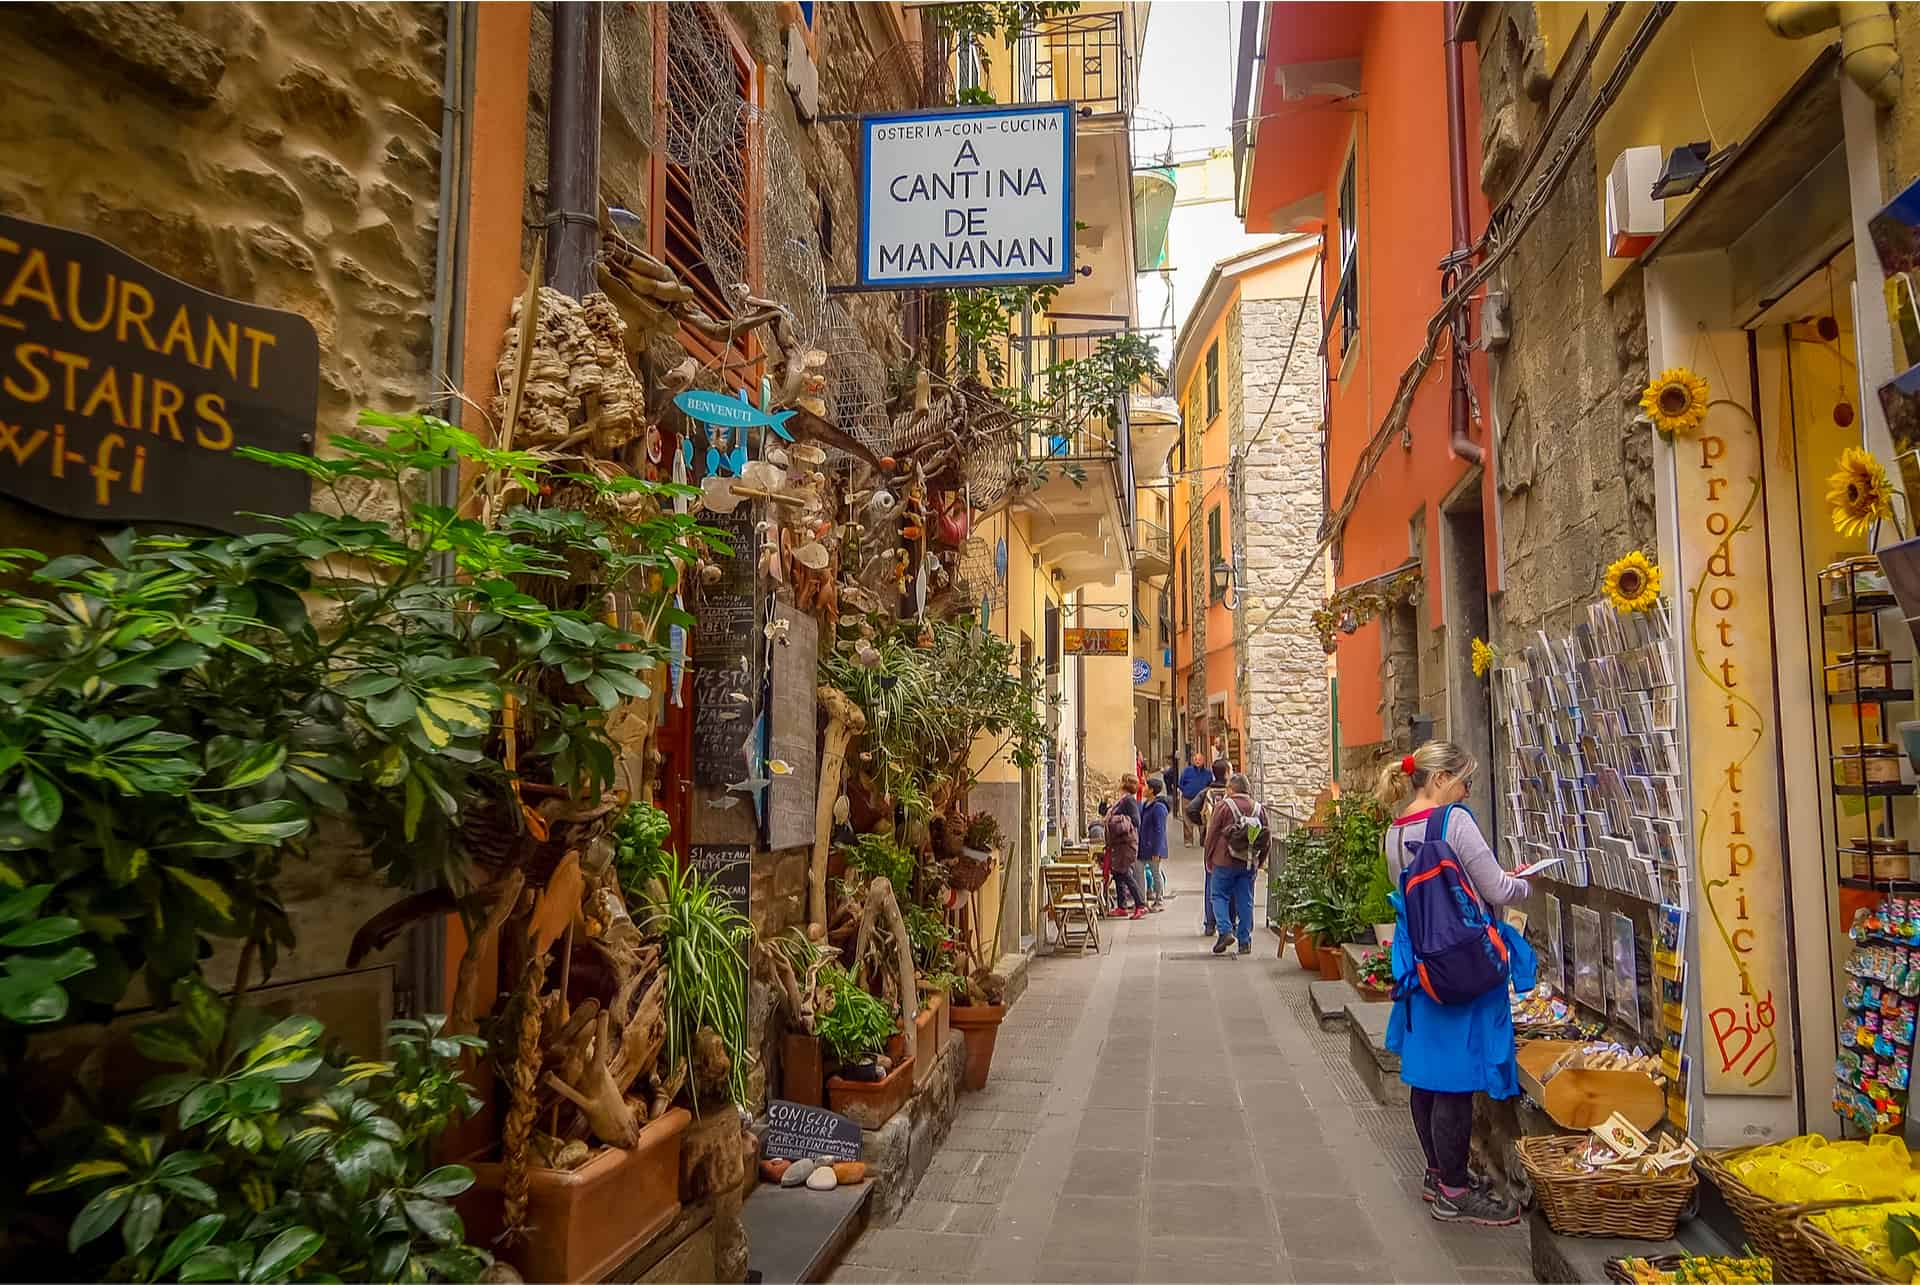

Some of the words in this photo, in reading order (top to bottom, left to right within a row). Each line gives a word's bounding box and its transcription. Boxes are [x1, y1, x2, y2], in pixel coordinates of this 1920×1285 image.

[953, 138, 981, 168] A
[889, 168, 1047, 203] CANTINA
[944, 207, 988, 238] DE
[879, 237, 1054, 274] MANANAN
[3, 342, 235, 451] STAIRS
[687, 398, 751, 422] BENVENUTI
[1698, 435, 1739, 729] prodotti
[1724, 761, 1754, 997] tipici
[769, 1104, 839, 1130] CONIGLIO
